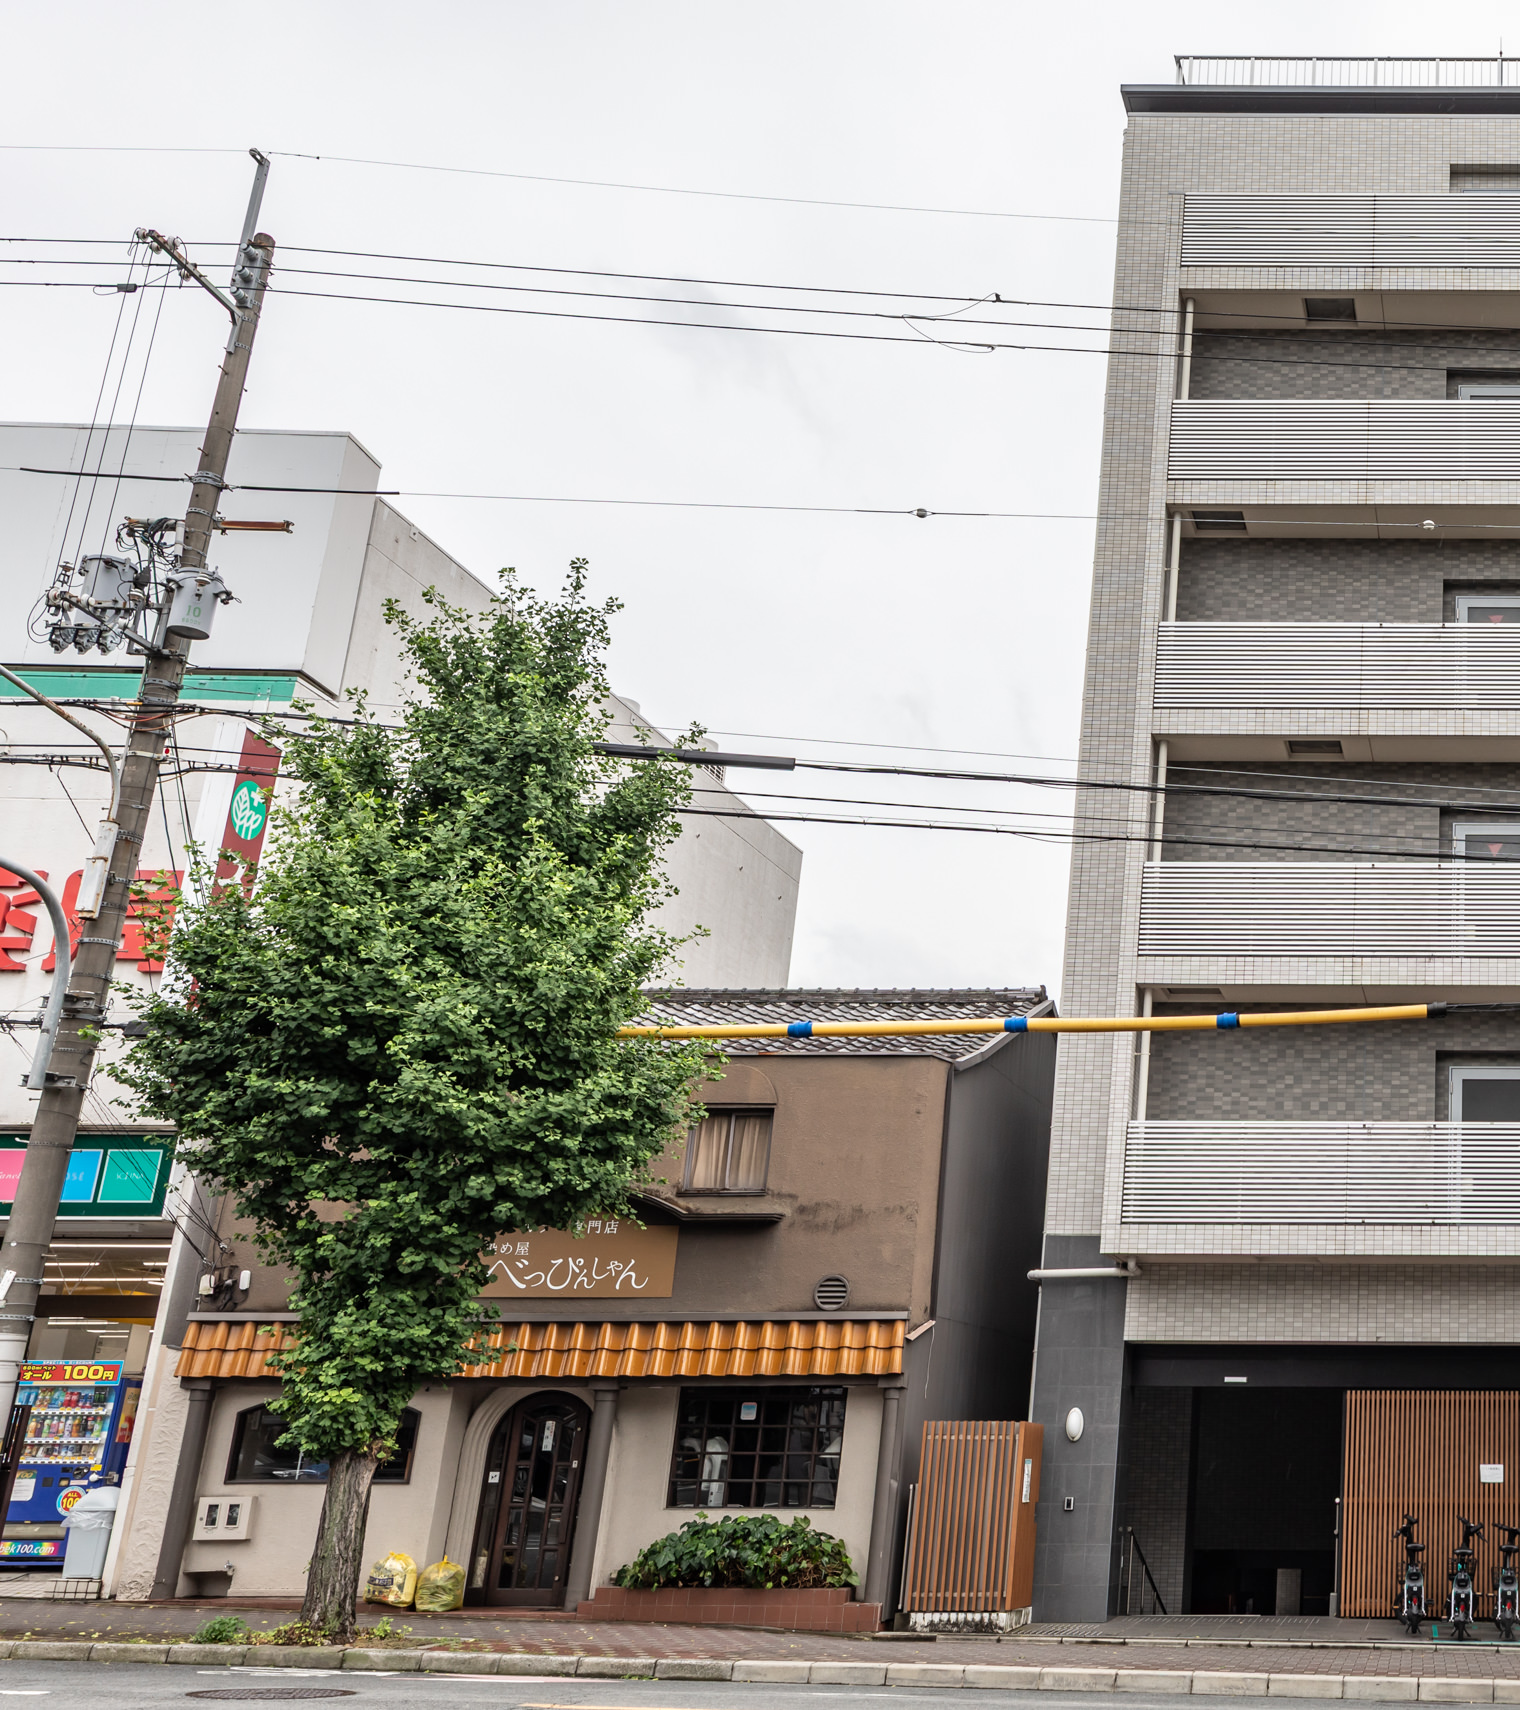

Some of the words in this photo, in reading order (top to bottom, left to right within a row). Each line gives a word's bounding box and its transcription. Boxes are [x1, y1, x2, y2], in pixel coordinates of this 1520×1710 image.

[486, 1256, 649, 1290] べっぴんしゃん
[22, 1371, 53, 1380] オール
[63, 1365, 115, 1380] 100円
